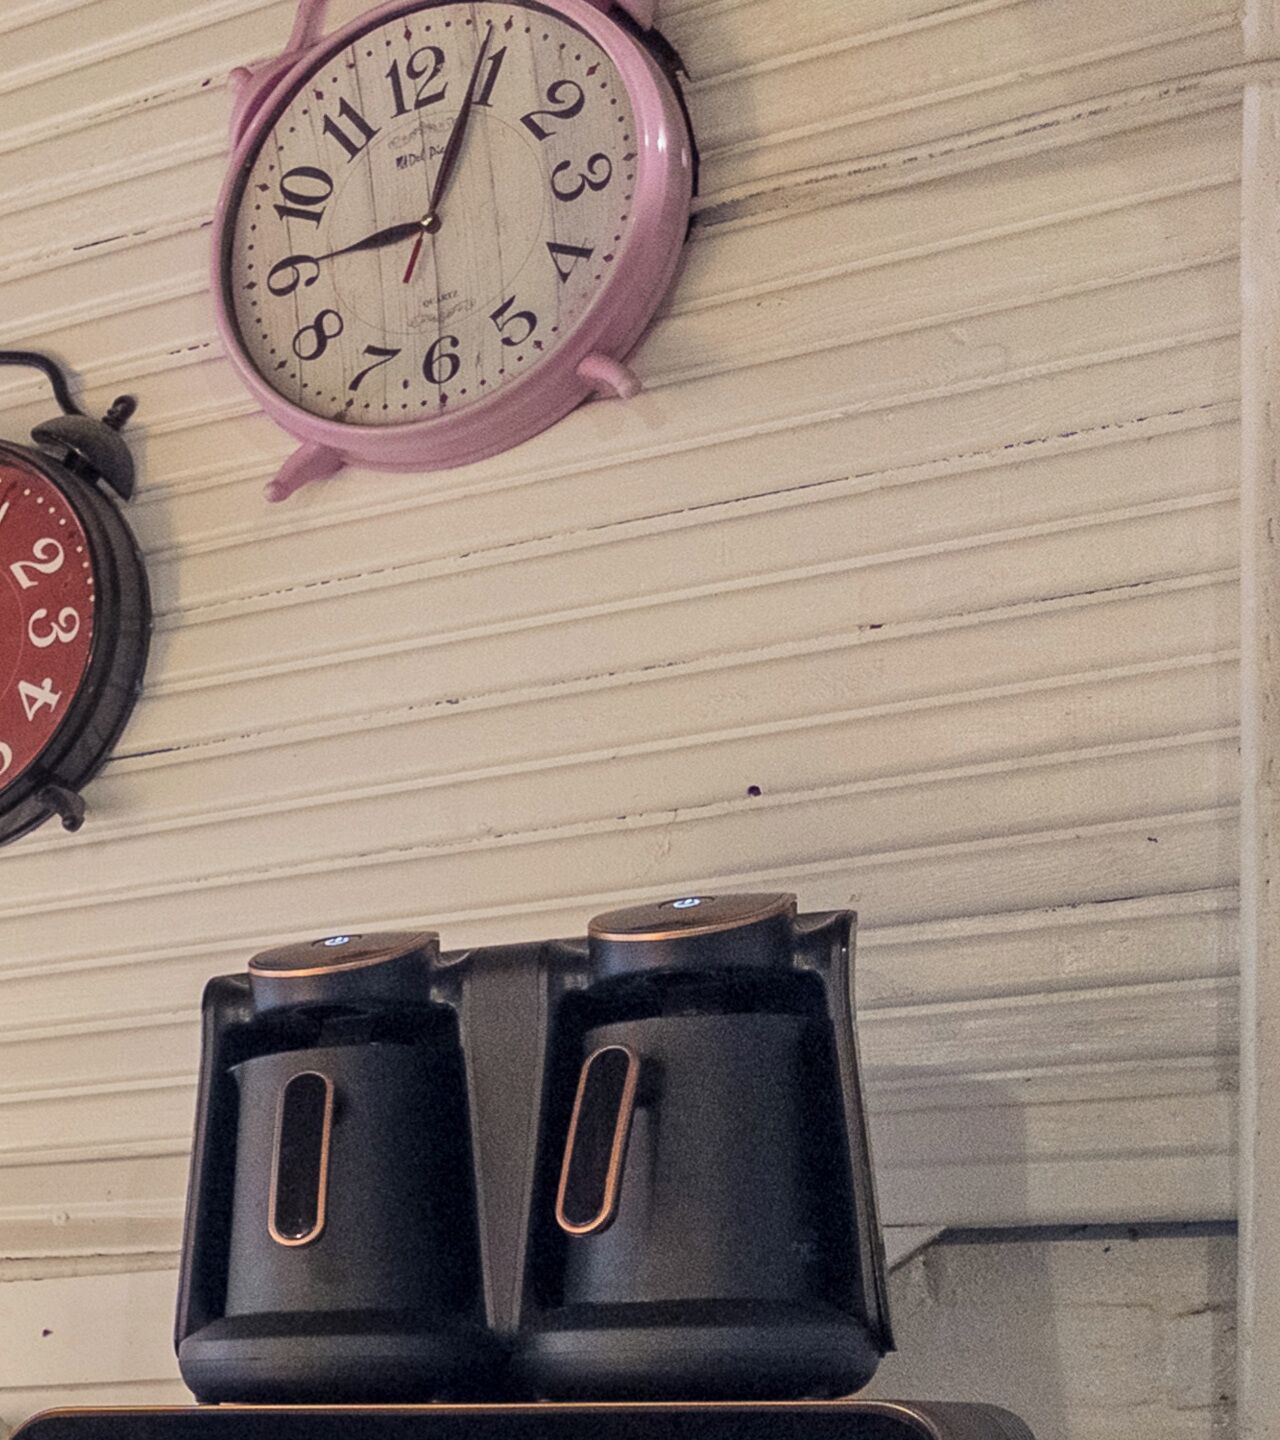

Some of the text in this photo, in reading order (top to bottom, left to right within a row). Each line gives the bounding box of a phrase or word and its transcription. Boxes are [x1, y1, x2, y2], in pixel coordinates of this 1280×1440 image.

[385, 45, 449, 119] 12
[471, 45, 509, 108] 1
[321, 95, 381, 164] 11
[520, 79, 585, 142] 2
[273, 166, 334, 230] 10
[550, 152, 612, 202] 3
[266, 254, 320, 297] 9
[545, 237, 595, 285] 4
[292, 308, 344, 361] 8
[489, 295, 538, 347] 5
[348, 344, 401, 391] 7
[422, 334, 461, 385] 6
[10, 537, 65, 589] 2
[28, 606, 80, 648] 3
[17, 677, 64, 722] 4
